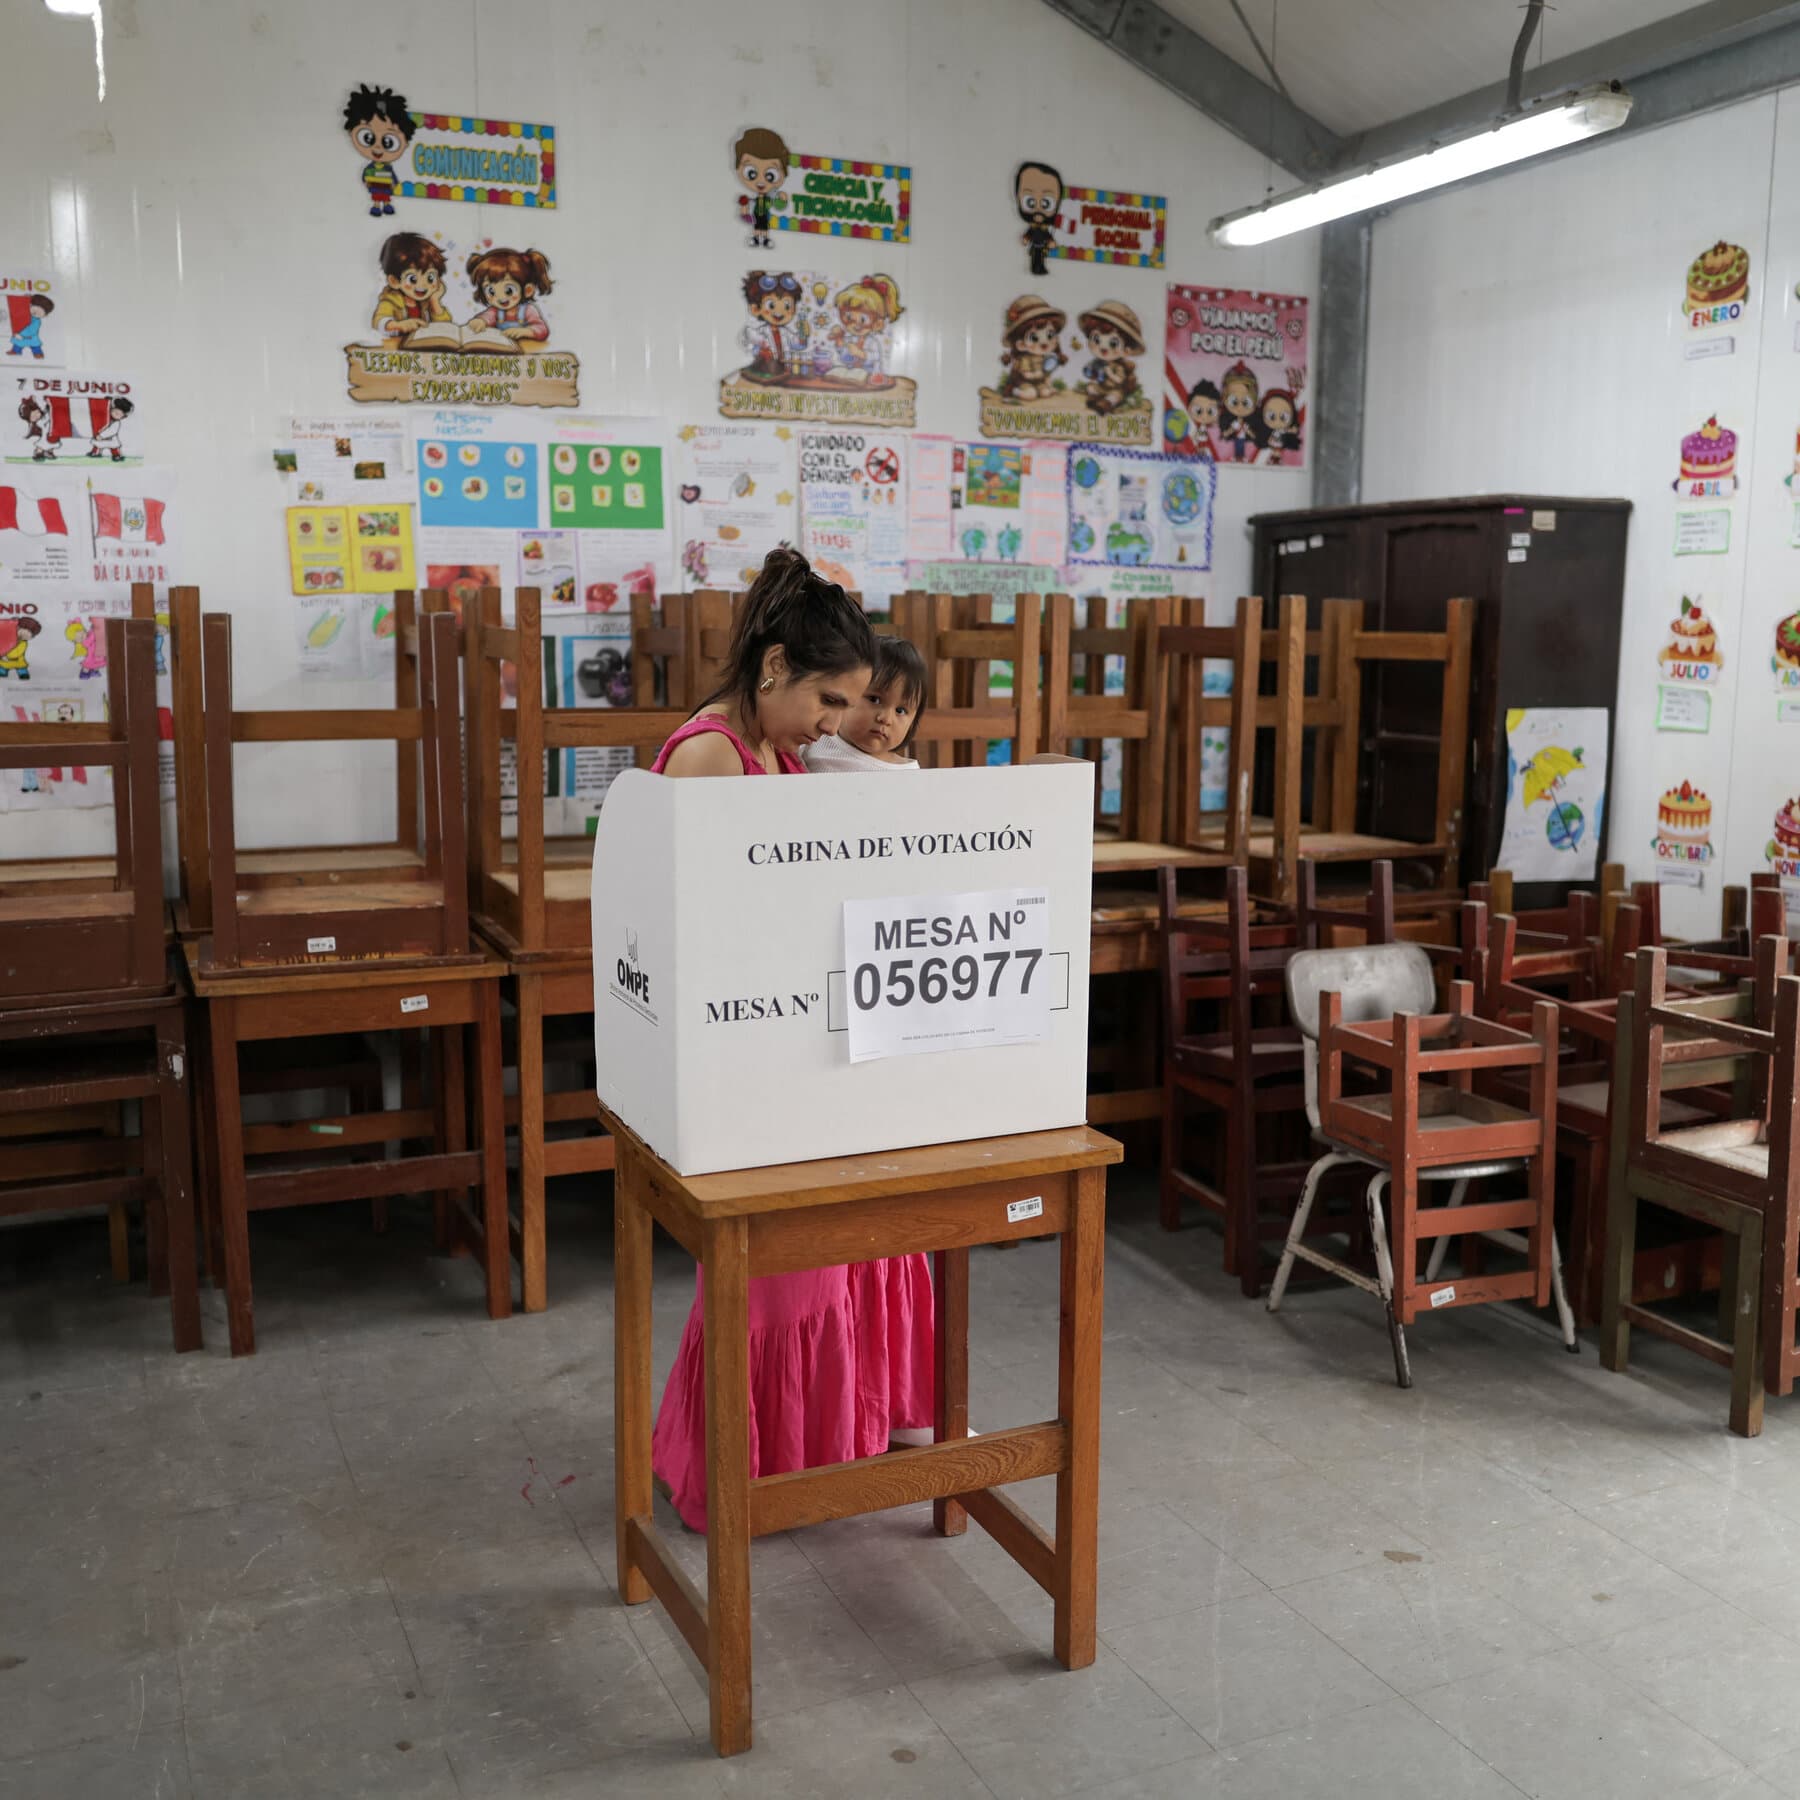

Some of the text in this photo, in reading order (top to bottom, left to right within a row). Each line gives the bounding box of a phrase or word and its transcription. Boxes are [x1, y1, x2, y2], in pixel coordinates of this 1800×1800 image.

[413, 143, 538, 185] COMUNICACIÓN
[804, 173, 884, 201] CIENCIA Y
[792, 194, 894, 225] TECNOLOGÍA
[1081, 205, 1152, 230] PERSONAL
[1094, 228, 1141, 250] SOCIAL
[1692, 303, 1740, 327] ENERO
[1191, 332, 1224, 355] POR
[1226, 335, 1242, 357] EL
[541, 359, 571, 380] NOS
[17, 378, 131, 394] 7 DE JUNIO
[1690, 481, 1721, 497] ABRIL
[1670, 664, 1709, 680] JULIO
[748, 824, 1033, 865] CABINA DE VOTACIÓN
[1659, 843, 1707, 861] OCTUBRE
[875, 910, 1026, 951] MESA Nº
[617, 958, 649, 1004] ONPE
[854, 948, 1043, 1011] 056977
[704, 993, 819, 1024] MESA Nº
